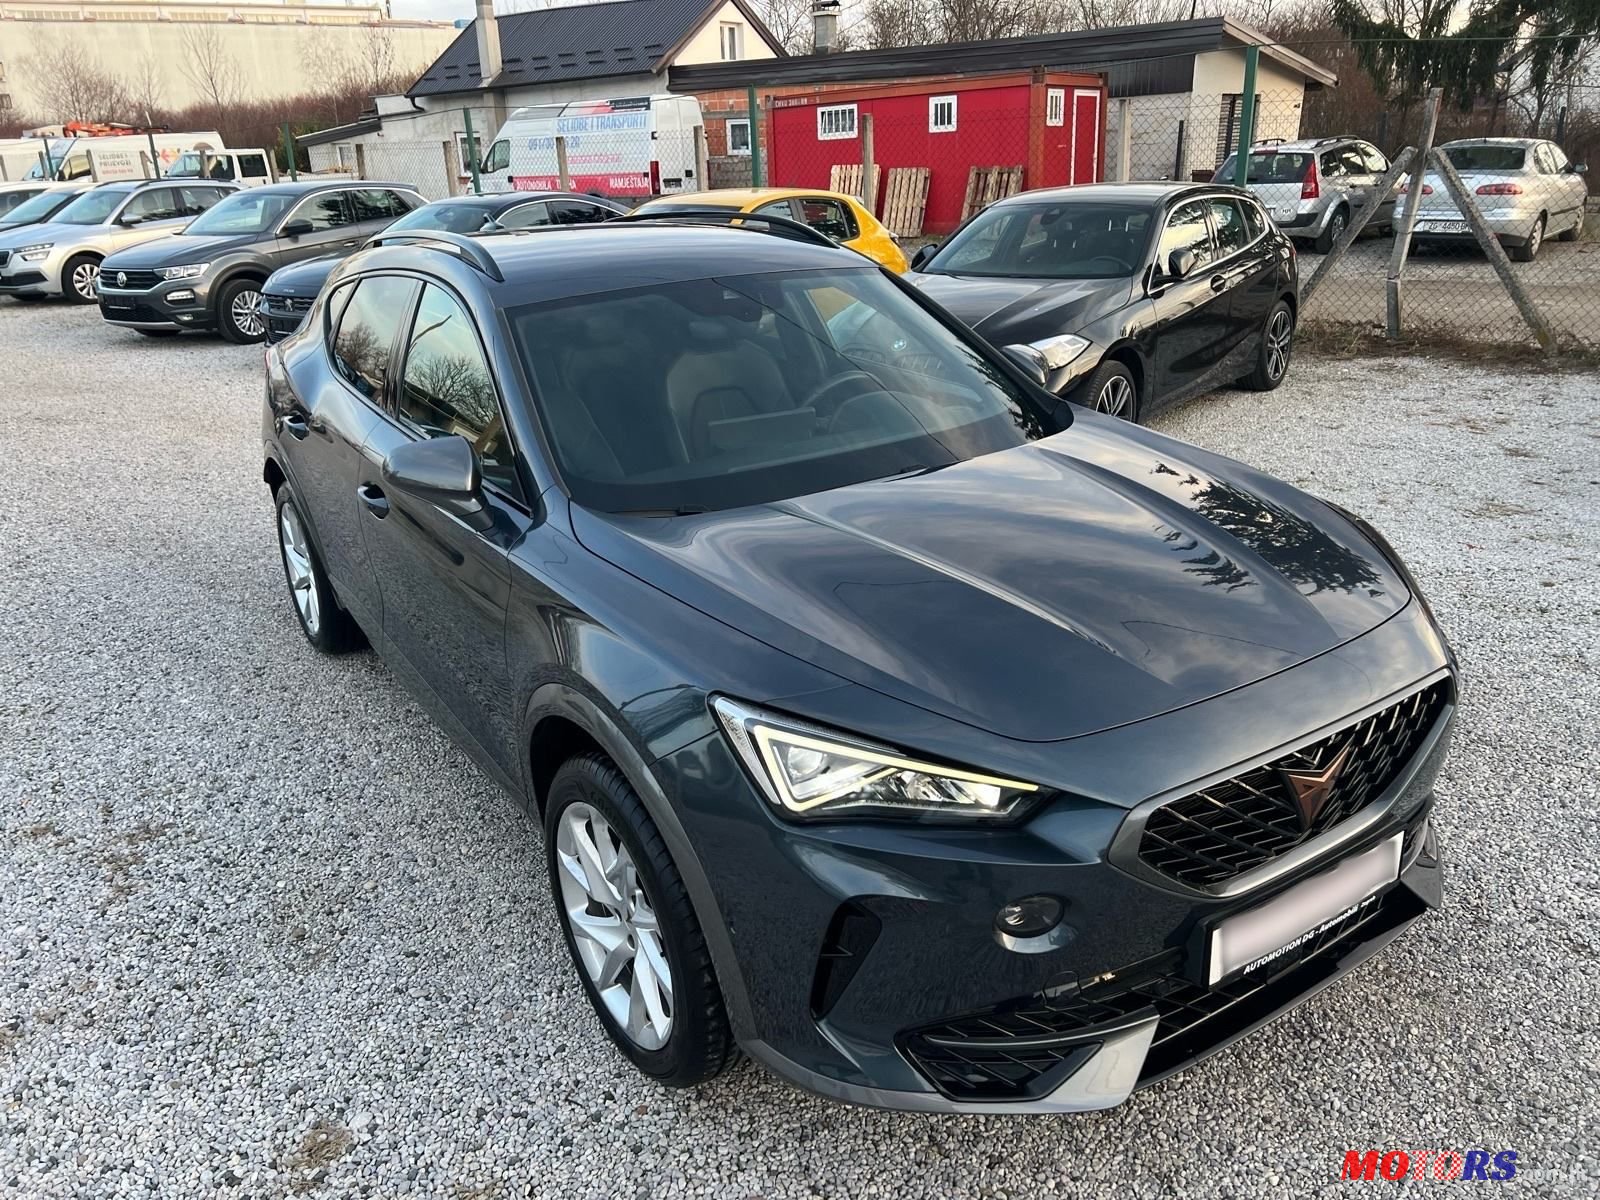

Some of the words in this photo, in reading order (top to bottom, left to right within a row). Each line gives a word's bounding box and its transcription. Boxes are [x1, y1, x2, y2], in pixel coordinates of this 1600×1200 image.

[1243, 936, 1302, 975] AUTOMOTION
[1301, 929, 1315, 944] DG
[1318, 903, 1359, 934] Automobili
